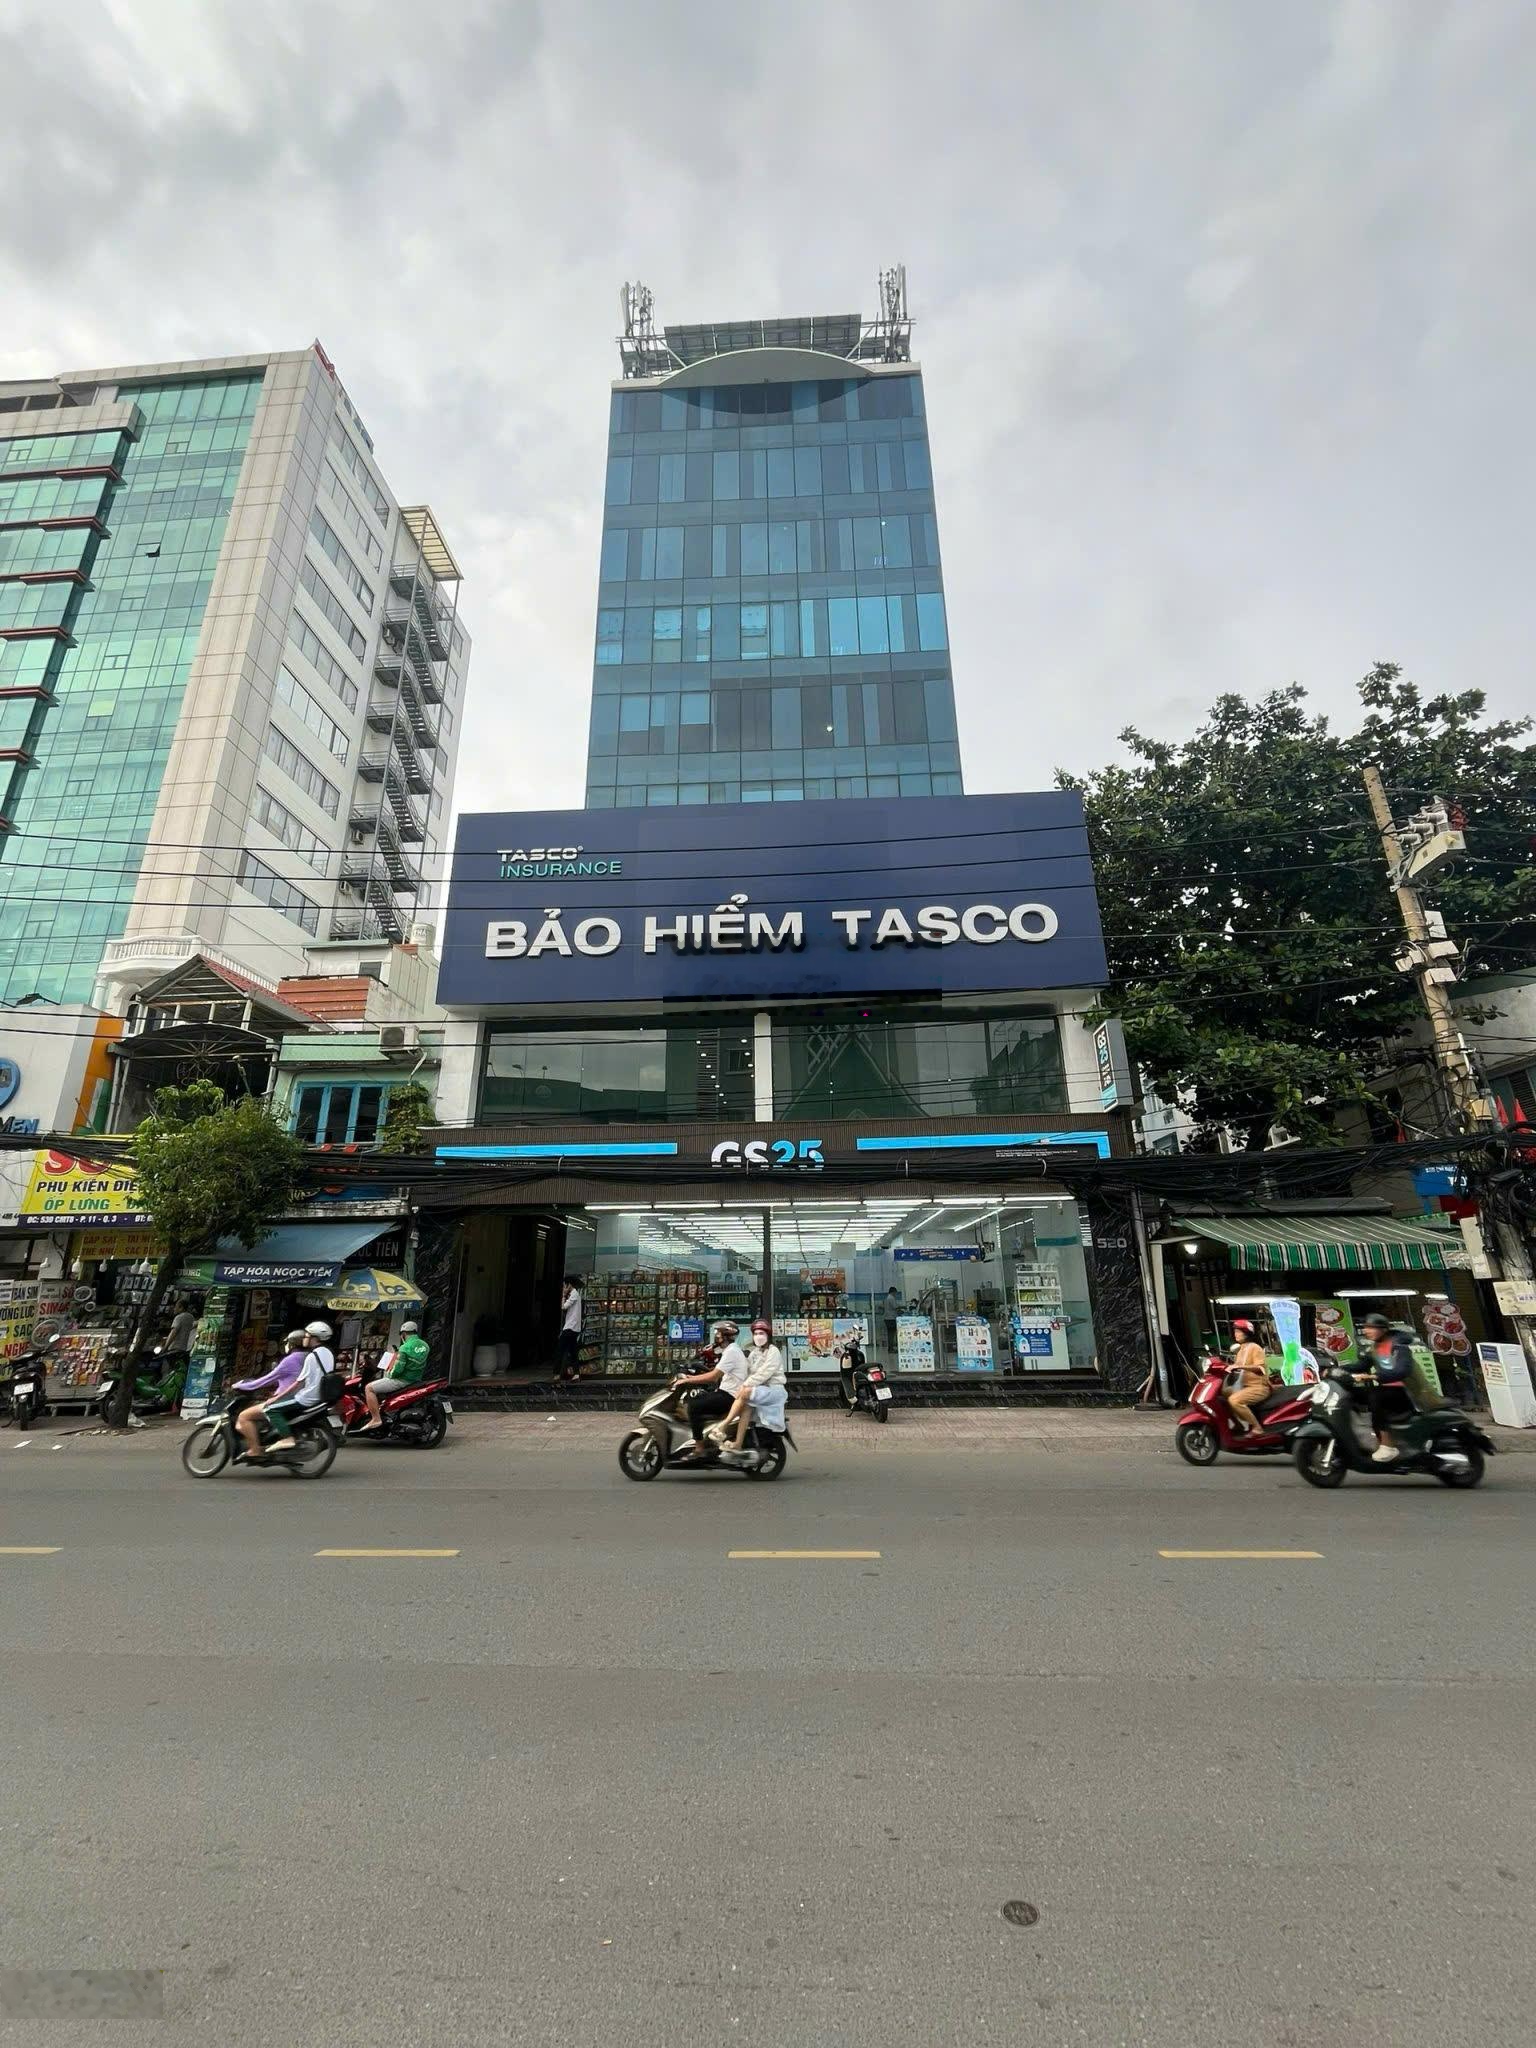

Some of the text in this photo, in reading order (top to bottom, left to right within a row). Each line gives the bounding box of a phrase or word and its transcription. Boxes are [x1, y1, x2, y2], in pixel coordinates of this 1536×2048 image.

[501, 861, 622, 877] INSURANCE
[485, 894, 1058, 957] BẢO HIỂM TASCO
[711, 1140, 824, 1170] GS25
[37, 1181, 68, 1195] PHỤ
[72, 1178, 108, 1194] KIỆN
[1097, 1238, 1128, 1249] 520
[223, 1266, 244, 1277] TẠP
[246, 1265, 270, 1276] HÓA
[273, 1267, 305, 1278] NGỌC
